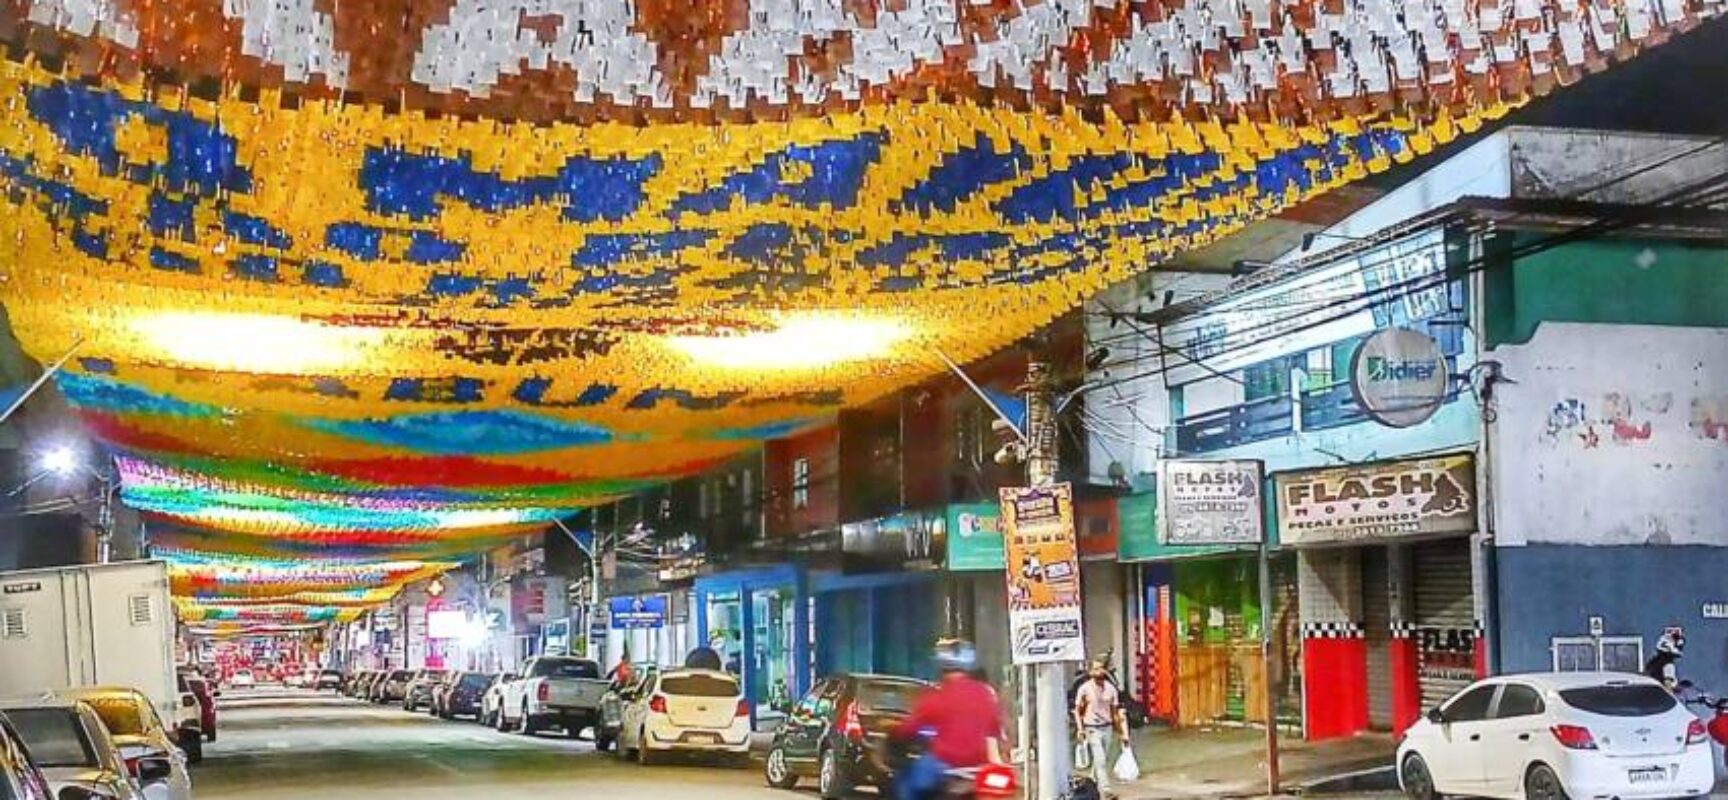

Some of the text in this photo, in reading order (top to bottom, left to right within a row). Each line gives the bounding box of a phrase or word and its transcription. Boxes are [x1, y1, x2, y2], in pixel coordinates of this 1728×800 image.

[1367, 357, 1436, 382] Didier
[1174, 472, 1242, 485] FLASH
[1288, 472, 1433, 506] FLASH
[1295, 498, 1417, 516] MOTOS
